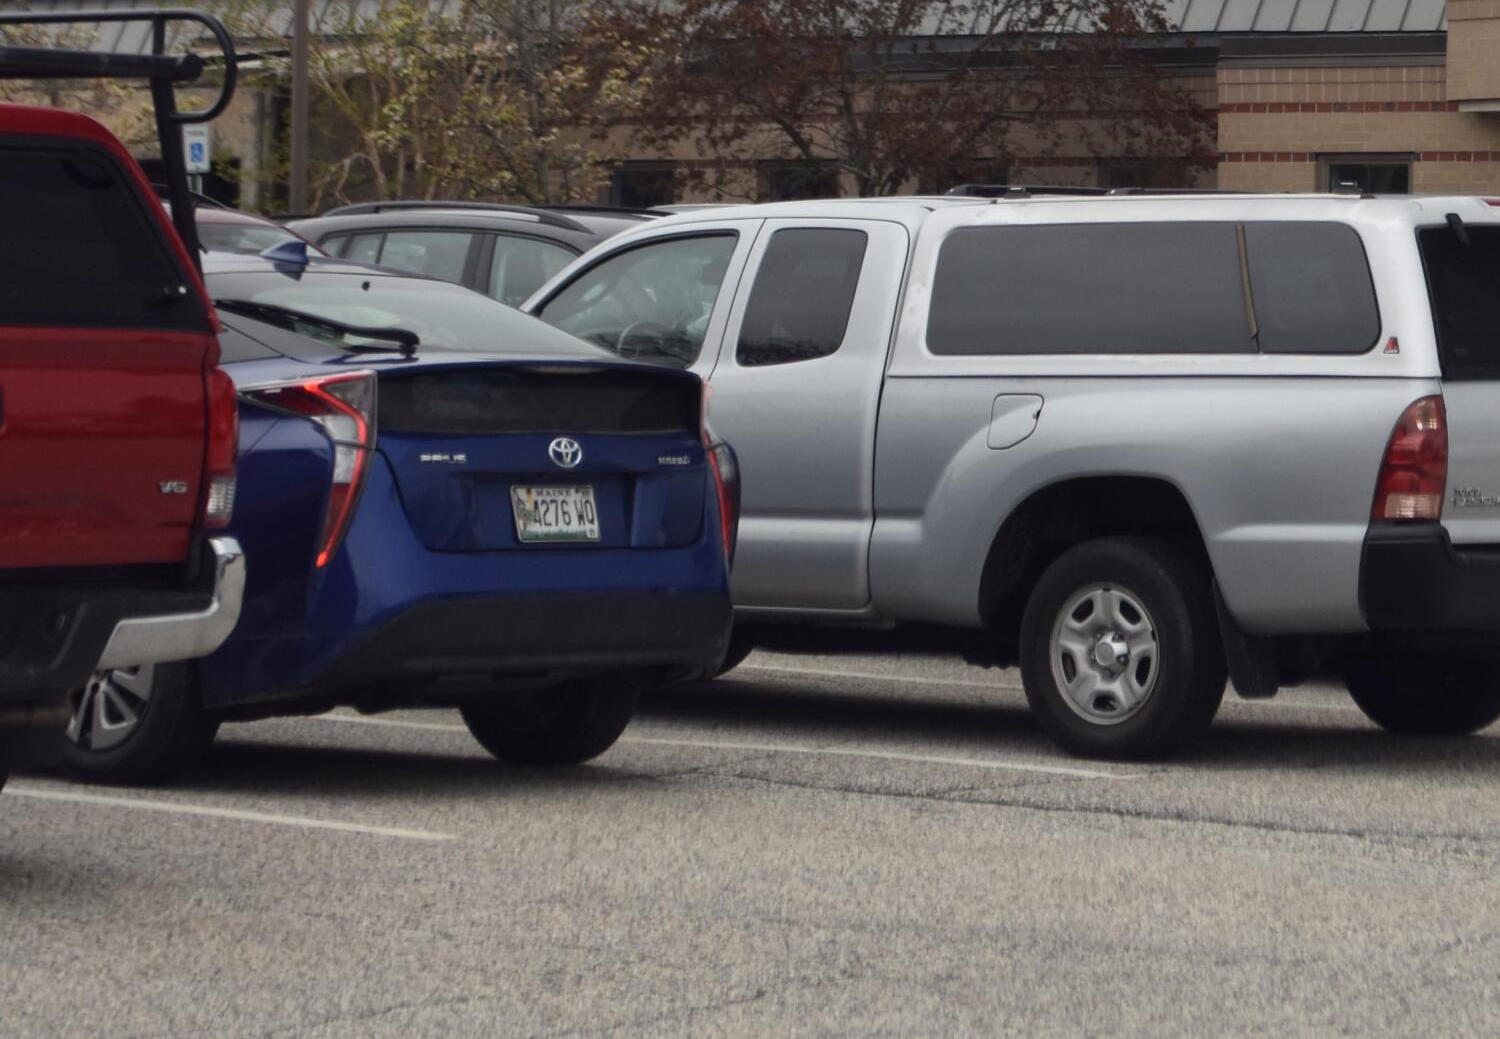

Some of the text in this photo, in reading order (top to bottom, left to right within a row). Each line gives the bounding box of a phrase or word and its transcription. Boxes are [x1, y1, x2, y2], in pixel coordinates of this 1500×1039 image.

[536, 489, 572, 497] MAINE
[533, 499, 596, 527] 4276 WQ
